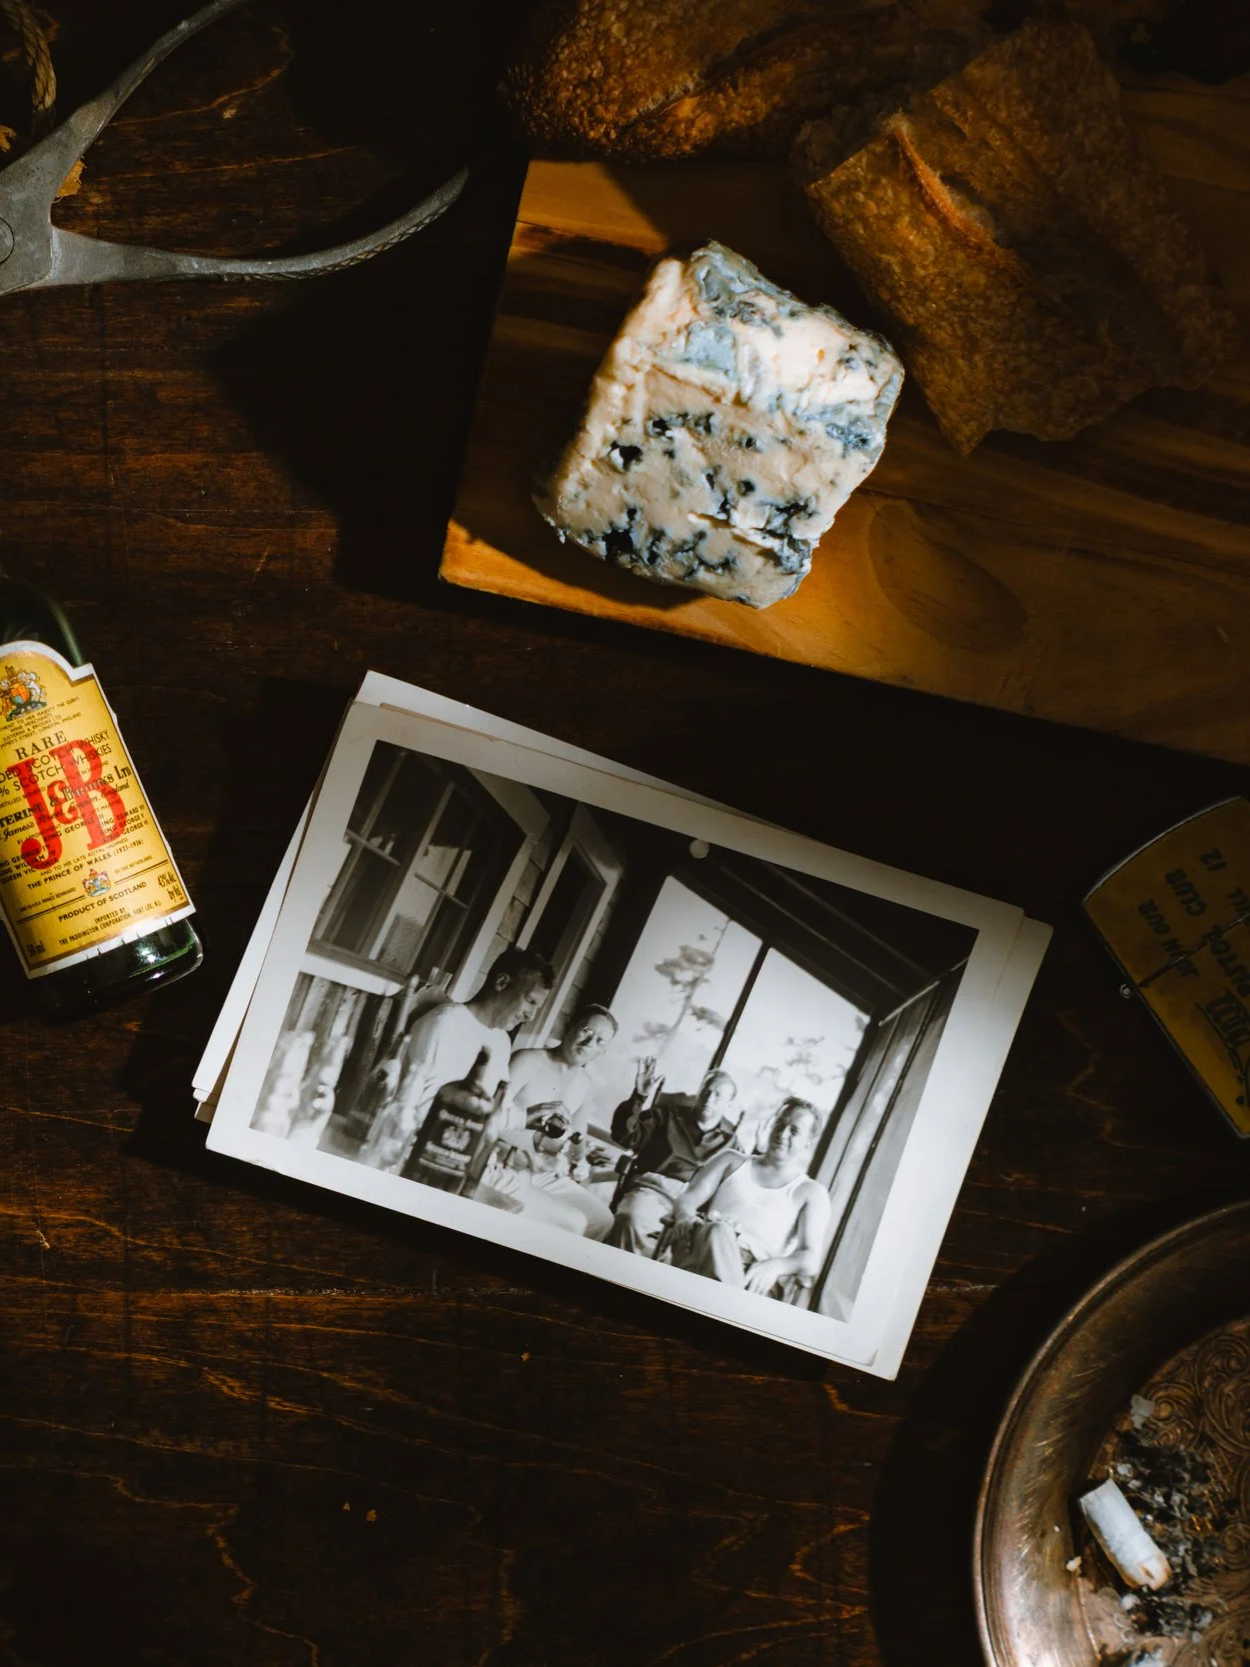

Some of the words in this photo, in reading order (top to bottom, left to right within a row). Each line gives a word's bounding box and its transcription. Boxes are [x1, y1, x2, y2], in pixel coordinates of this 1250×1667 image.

[15, 731, 67, 761] RARE
[25, 744, 76, 772] SCOTCH
[78, 730, 110, 751] WHISKY
[13, 763, 65, 791] SCOTCH
[69, 744, 112, 768] WHISKIES
[7, 740, 125, 869] J&B
[27, 880, 41, 890] THE
[43, 868, 71, 884] PRINCE
[74, 863, 85, 872] OF
[86, 852, 112, 866] WALES
[58, 903, 95, 922] PRODUCT
[97, 898, 108, 907] OF
[108, 881, 147, 902] SCOTLAND
[1165, 868, 1207, 917] CLUB
[69, 925, 99, 942] PADDINGTON
